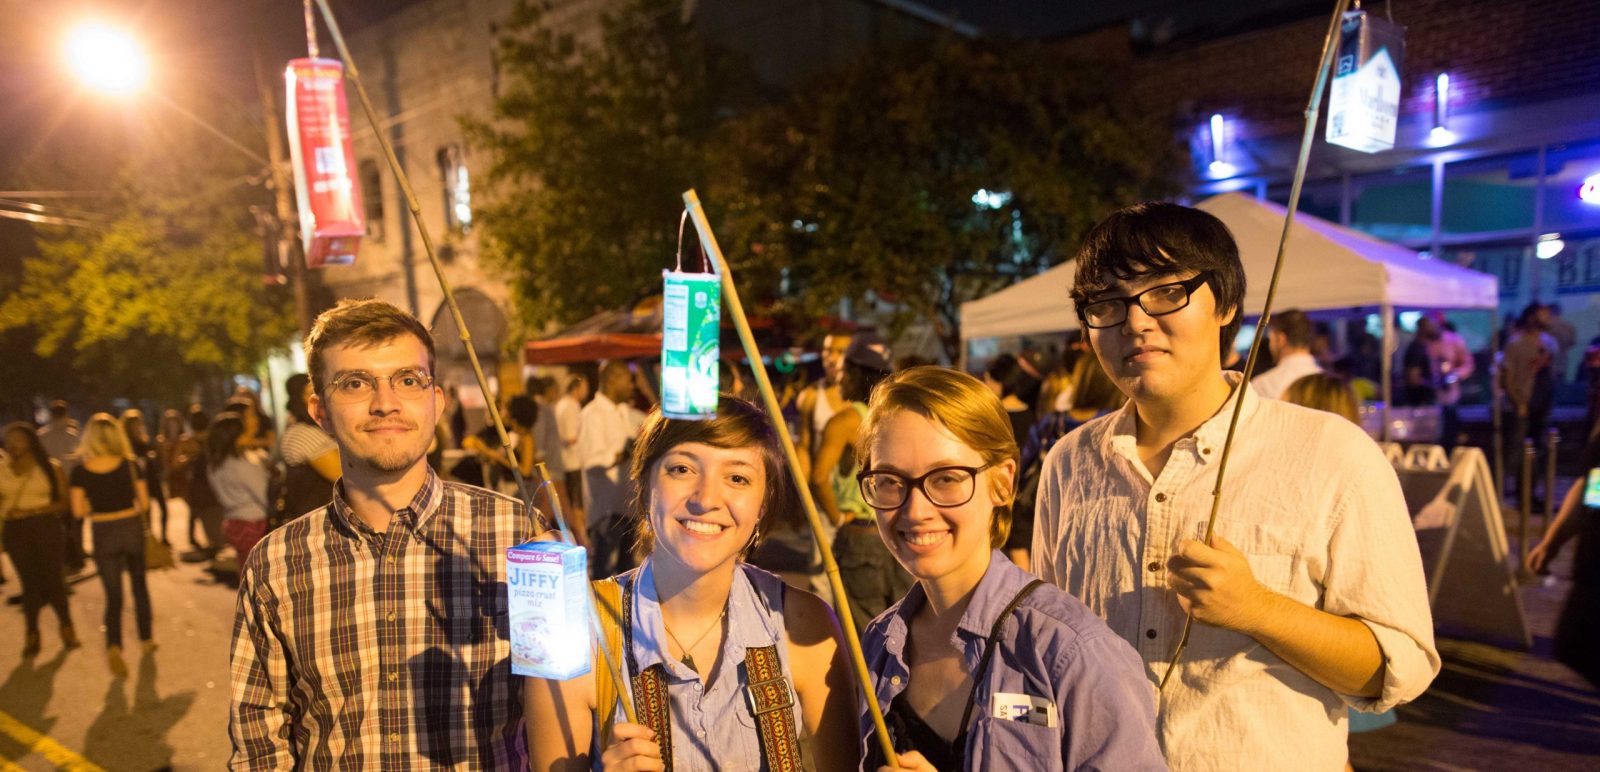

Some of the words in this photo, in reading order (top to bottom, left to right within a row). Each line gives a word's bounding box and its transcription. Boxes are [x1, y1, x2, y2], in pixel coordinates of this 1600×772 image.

[508, 552, 535, 561] Compare
[542, 555, 560, 563] Save!
[509, 567, 559, 589] JIFFY
[514, 589, 535, 598] pizza
[536, 591, 556, 600] crust
